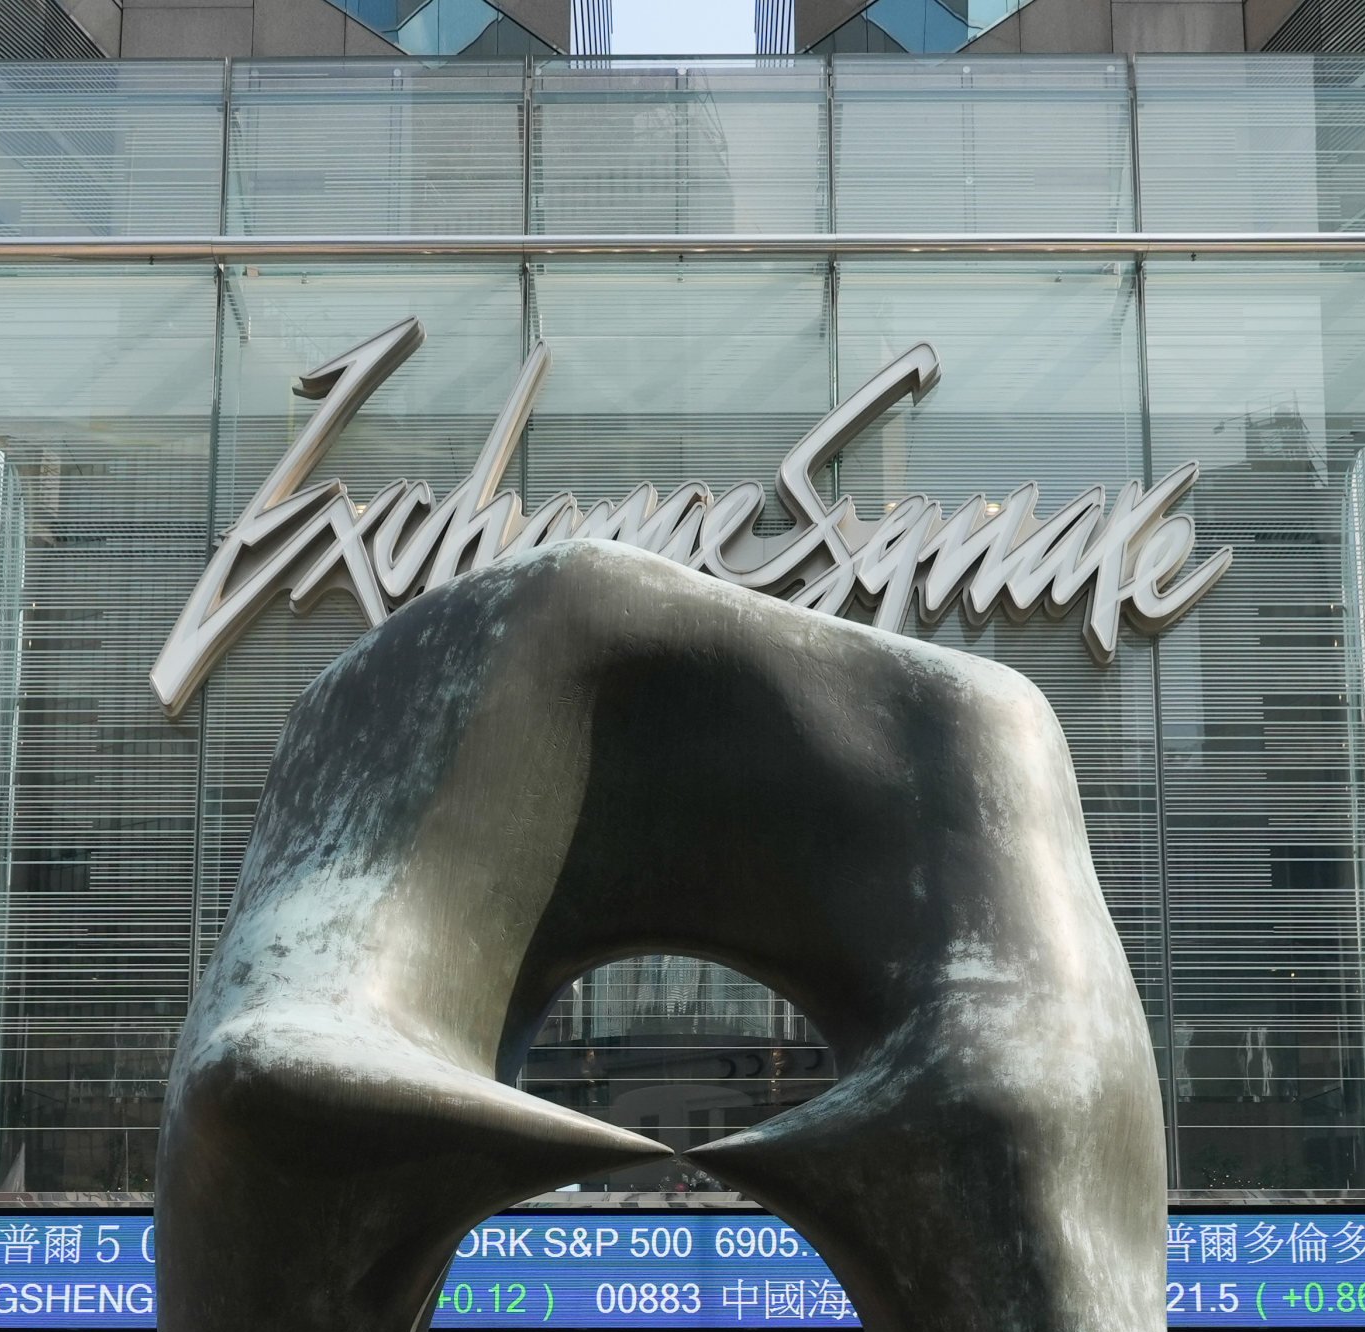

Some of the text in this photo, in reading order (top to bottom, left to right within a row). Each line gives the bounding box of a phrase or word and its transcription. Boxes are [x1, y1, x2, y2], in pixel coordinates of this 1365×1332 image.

[776, 340, 1233, 668] Square
[544, 1228, 618, 1257] S&P
[631, 1228, 692, 1257] 500
[715, 1227, 820, 1258] 6905.
[597, 1283, 700, 1313] 00883
[722, 1279, 858, 1320] 中國海
